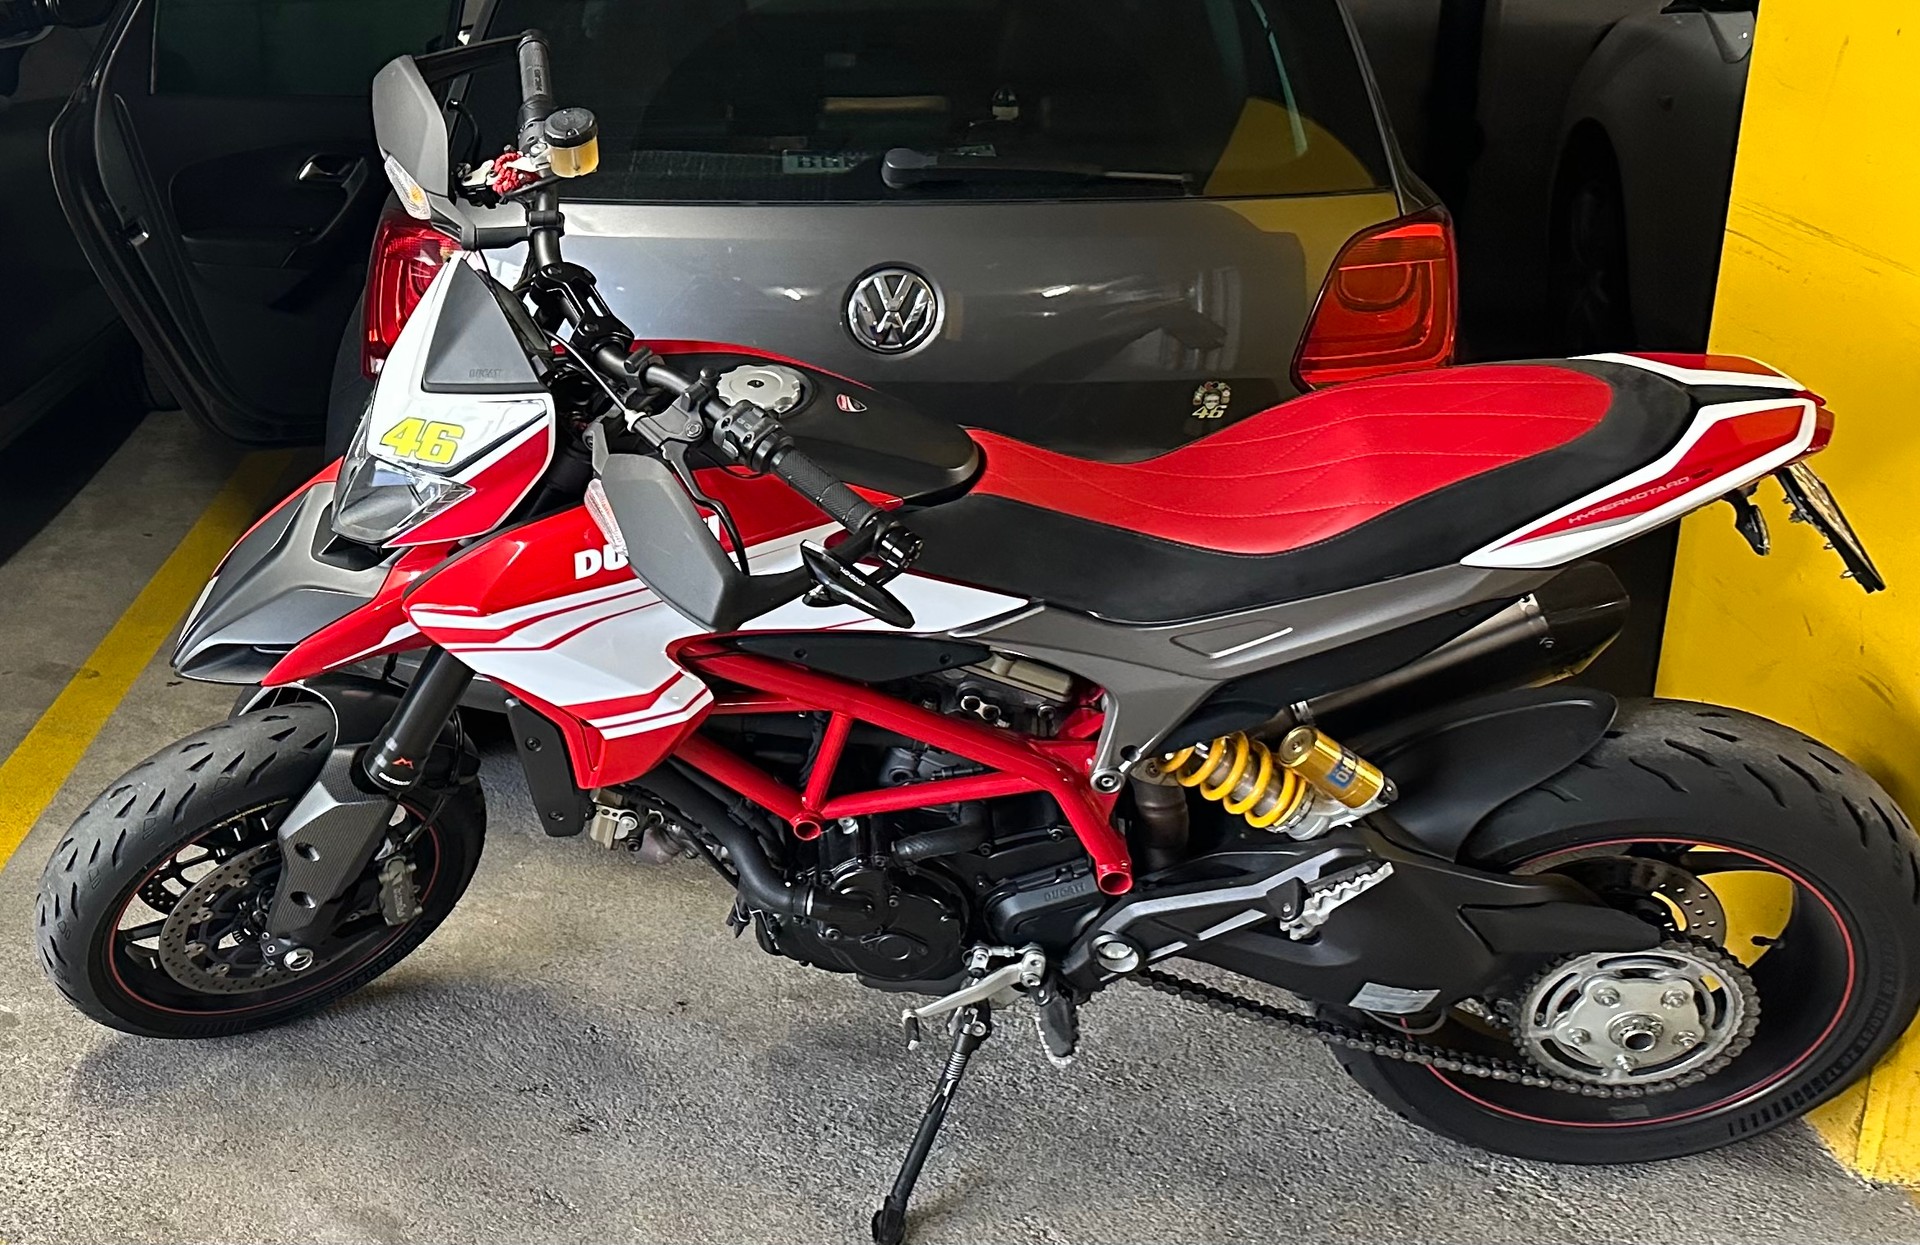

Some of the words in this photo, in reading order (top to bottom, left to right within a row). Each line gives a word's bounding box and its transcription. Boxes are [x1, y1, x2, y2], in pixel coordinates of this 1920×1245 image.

[1192, 405, 1228, 419] 46
[380, 416, 465, 464] 46
[1568, 475, 1691, 524] HYPERMOTARD
[1044, 881, 1086, 902] DUCATI
